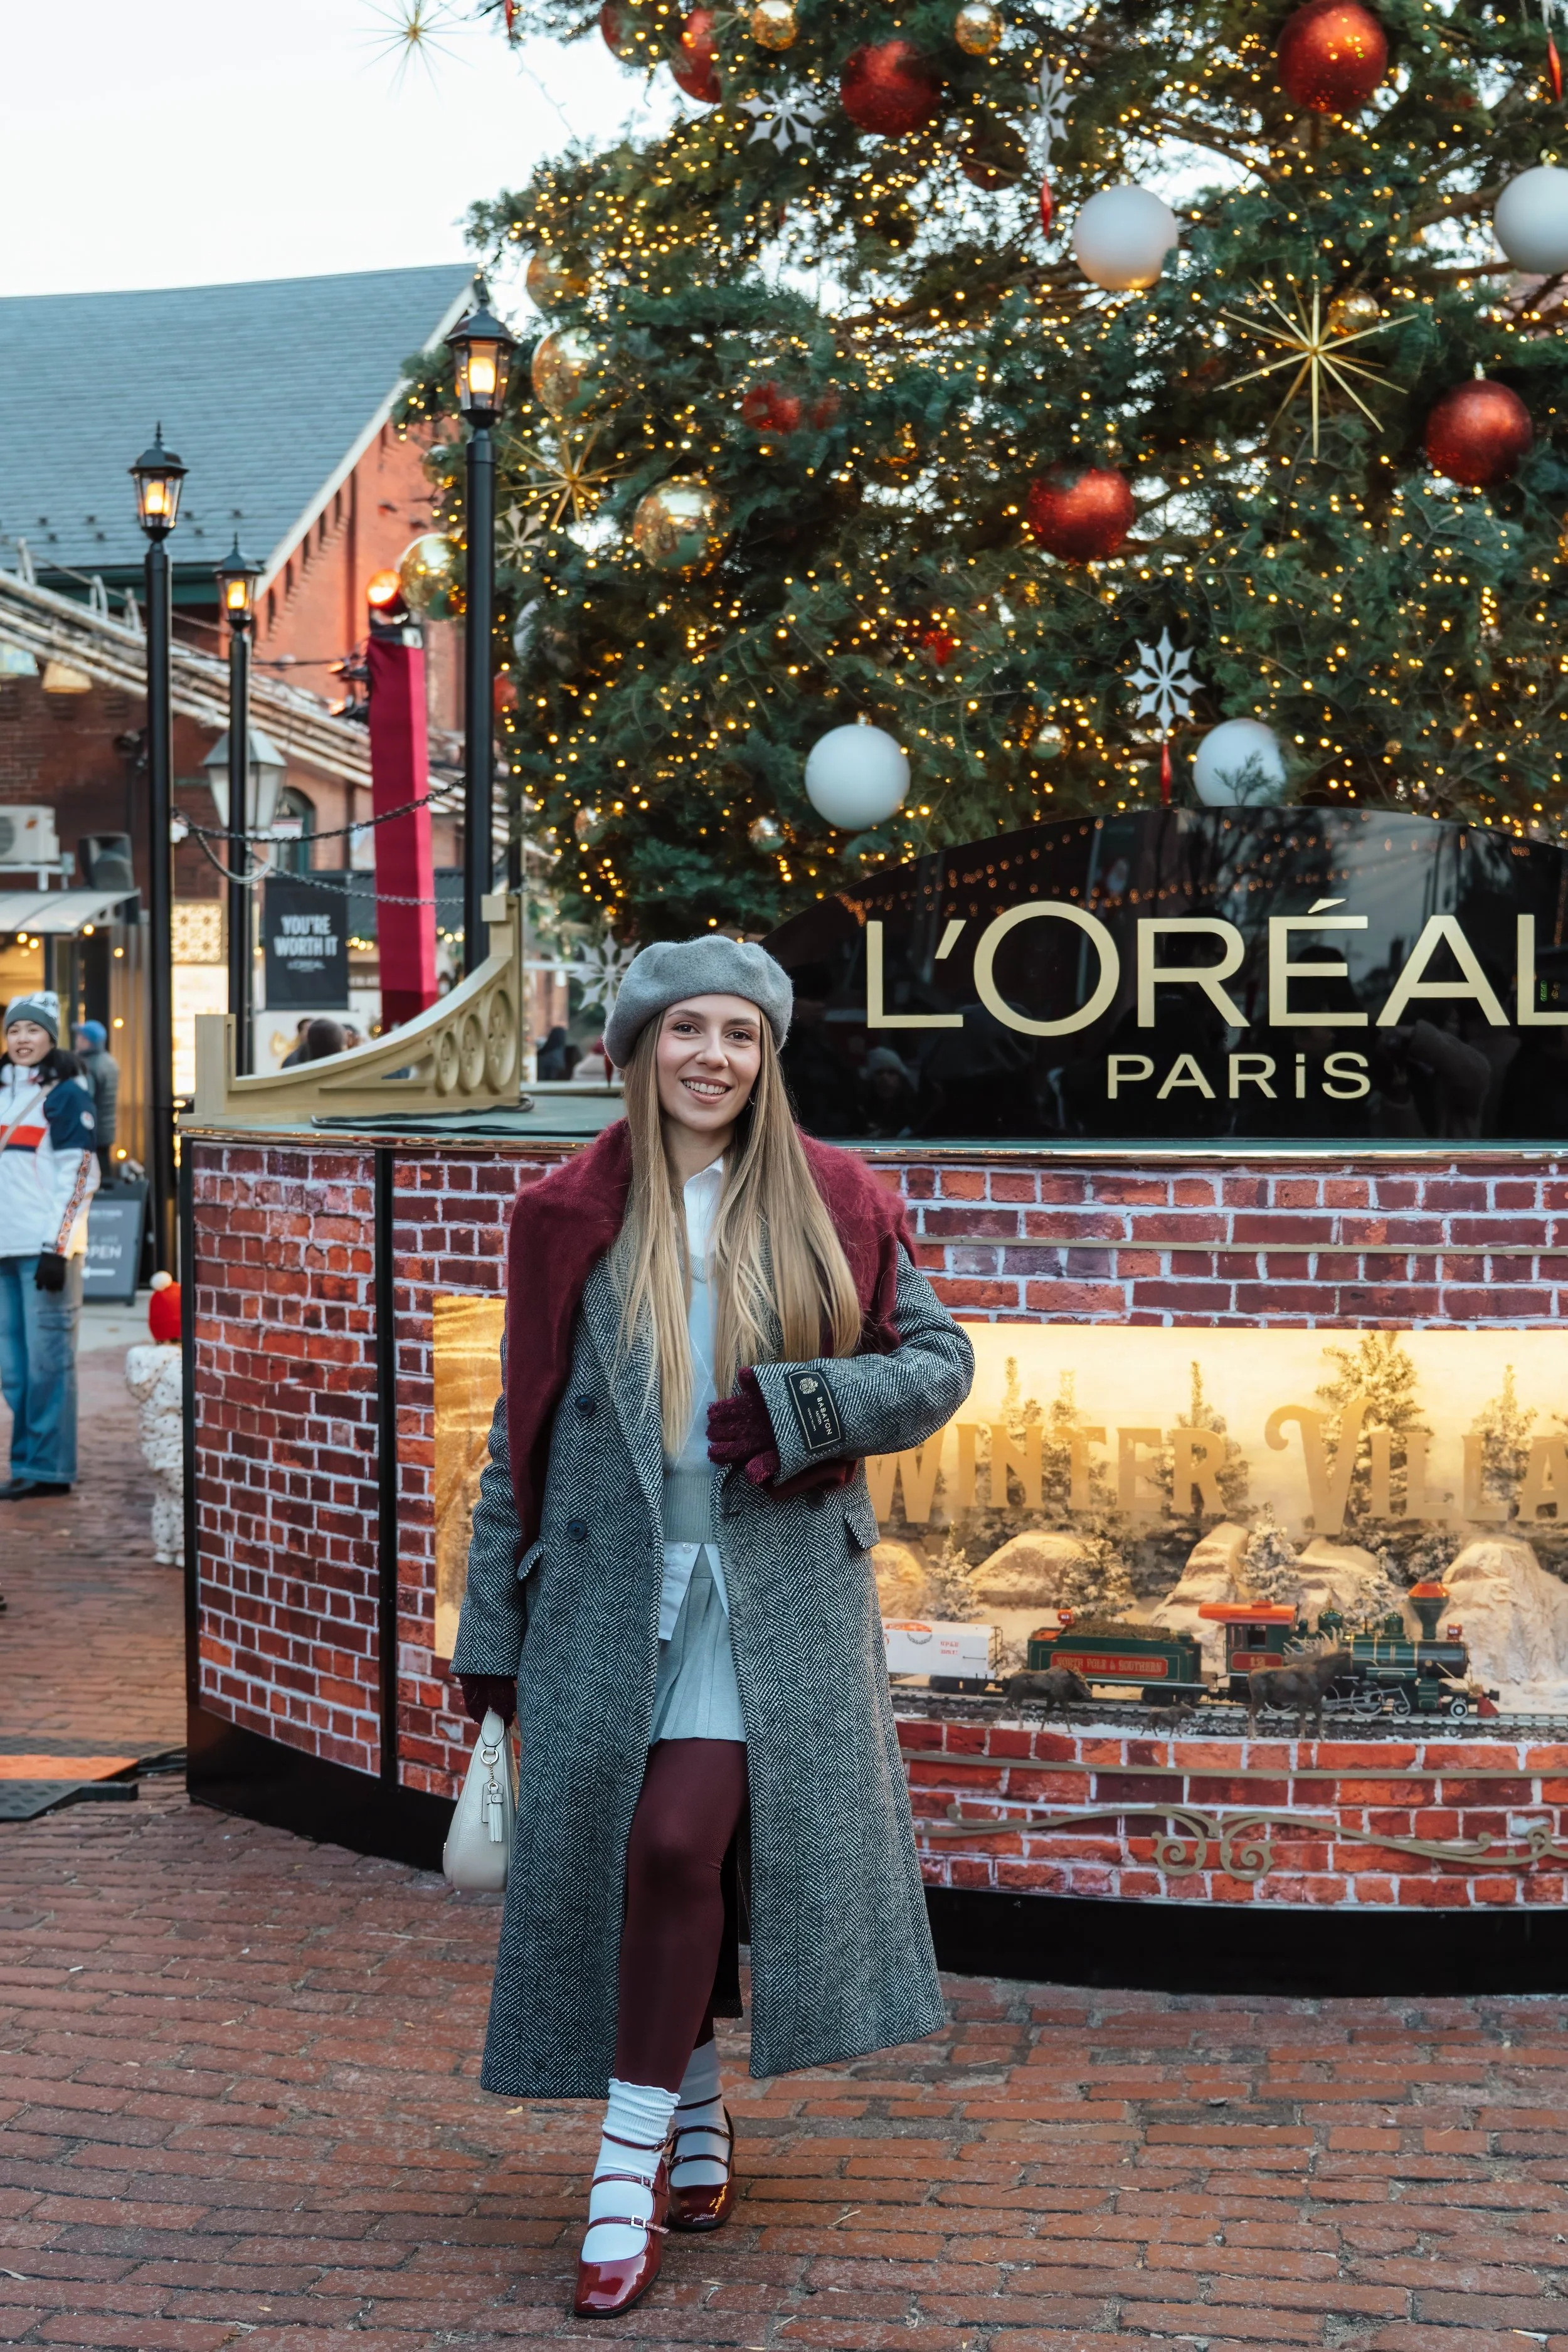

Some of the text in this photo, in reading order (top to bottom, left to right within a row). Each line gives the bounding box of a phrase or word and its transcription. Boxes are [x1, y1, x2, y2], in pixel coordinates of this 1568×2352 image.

[281, 915, 331, 935] YOU'RE
[273, 935, 338, 956] WORTH IT
[867, 898, 1568, 1037] L'ORÉAL
[866, 1424, 1228, 1523] WINTER
[1056, 1656, 1084, 1669] NORTH
[1086, 1657, 1106, 1670] POLE
[1118, 1660, 1162, 1673] SOUTHERN
